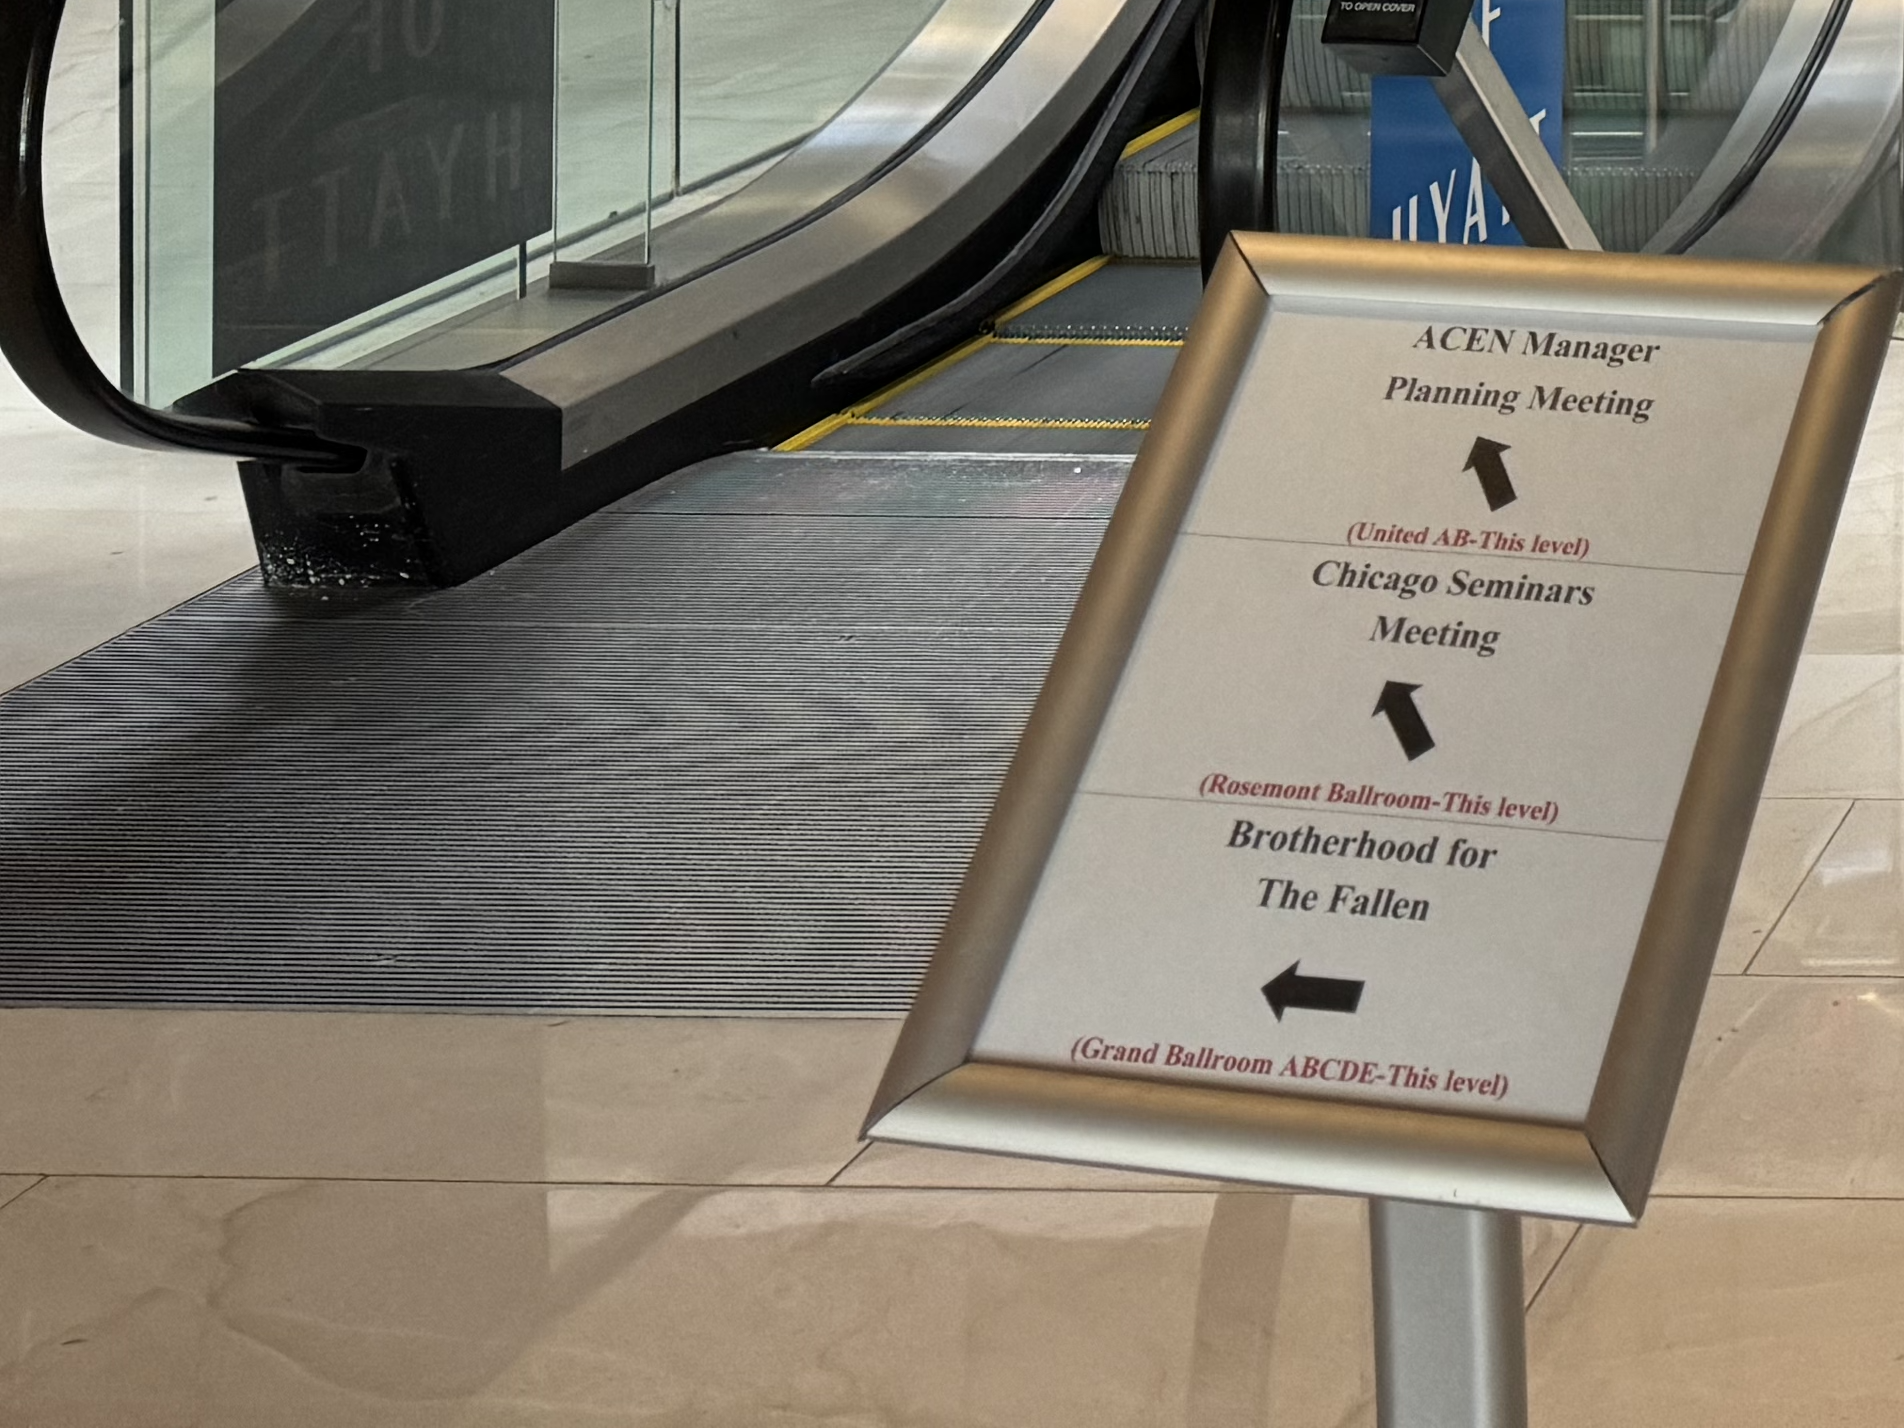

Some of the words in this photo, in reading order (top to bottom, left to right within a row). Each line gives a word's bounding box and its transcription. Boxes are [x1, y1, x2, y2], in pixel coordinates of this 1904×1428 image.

[1340, 1, 1353, 10] TO
[1354, 2, 1381, 11] OPEN
[1382, 3, 1415, 12] COVER
[1412, 325, 1516, 353] ACEN
[1522, 331, 1660, 367] Manager
[1383, 375, 1520, 415] Planning
[1527, 385, 1655, 423] Meeting
[1347, 521, 1429, 544] (United
[1432, 528, 1525, 552] AB-This
[1531, 535, 1590, 559] level)
[1312, 560, 1438, 599] Chicago
[1446, 569, 1595, 605] Seminars
[1370, 615, 1500, 657] Meeting
[1199, 773, 1322, 801] (Rosemont
[1327, 782, 1492, 816] Ballroom-This
[1499, 798, 1559, 825] level)
[1227, 819, 1439, 864] Brotherhood
[1445, 838, 1497, 869] for
[1257, 878, 1318, 911] The
[1327, 884, 1430, 921] Fallen
[1071, 1036, 1159, 1064] (Grand
[1164, 1044, 1272, 1075] Ballroom
[1279, 1055, 1439, 1090] ABCDE-This
[1444, 1070, 1509, 1100] level)
